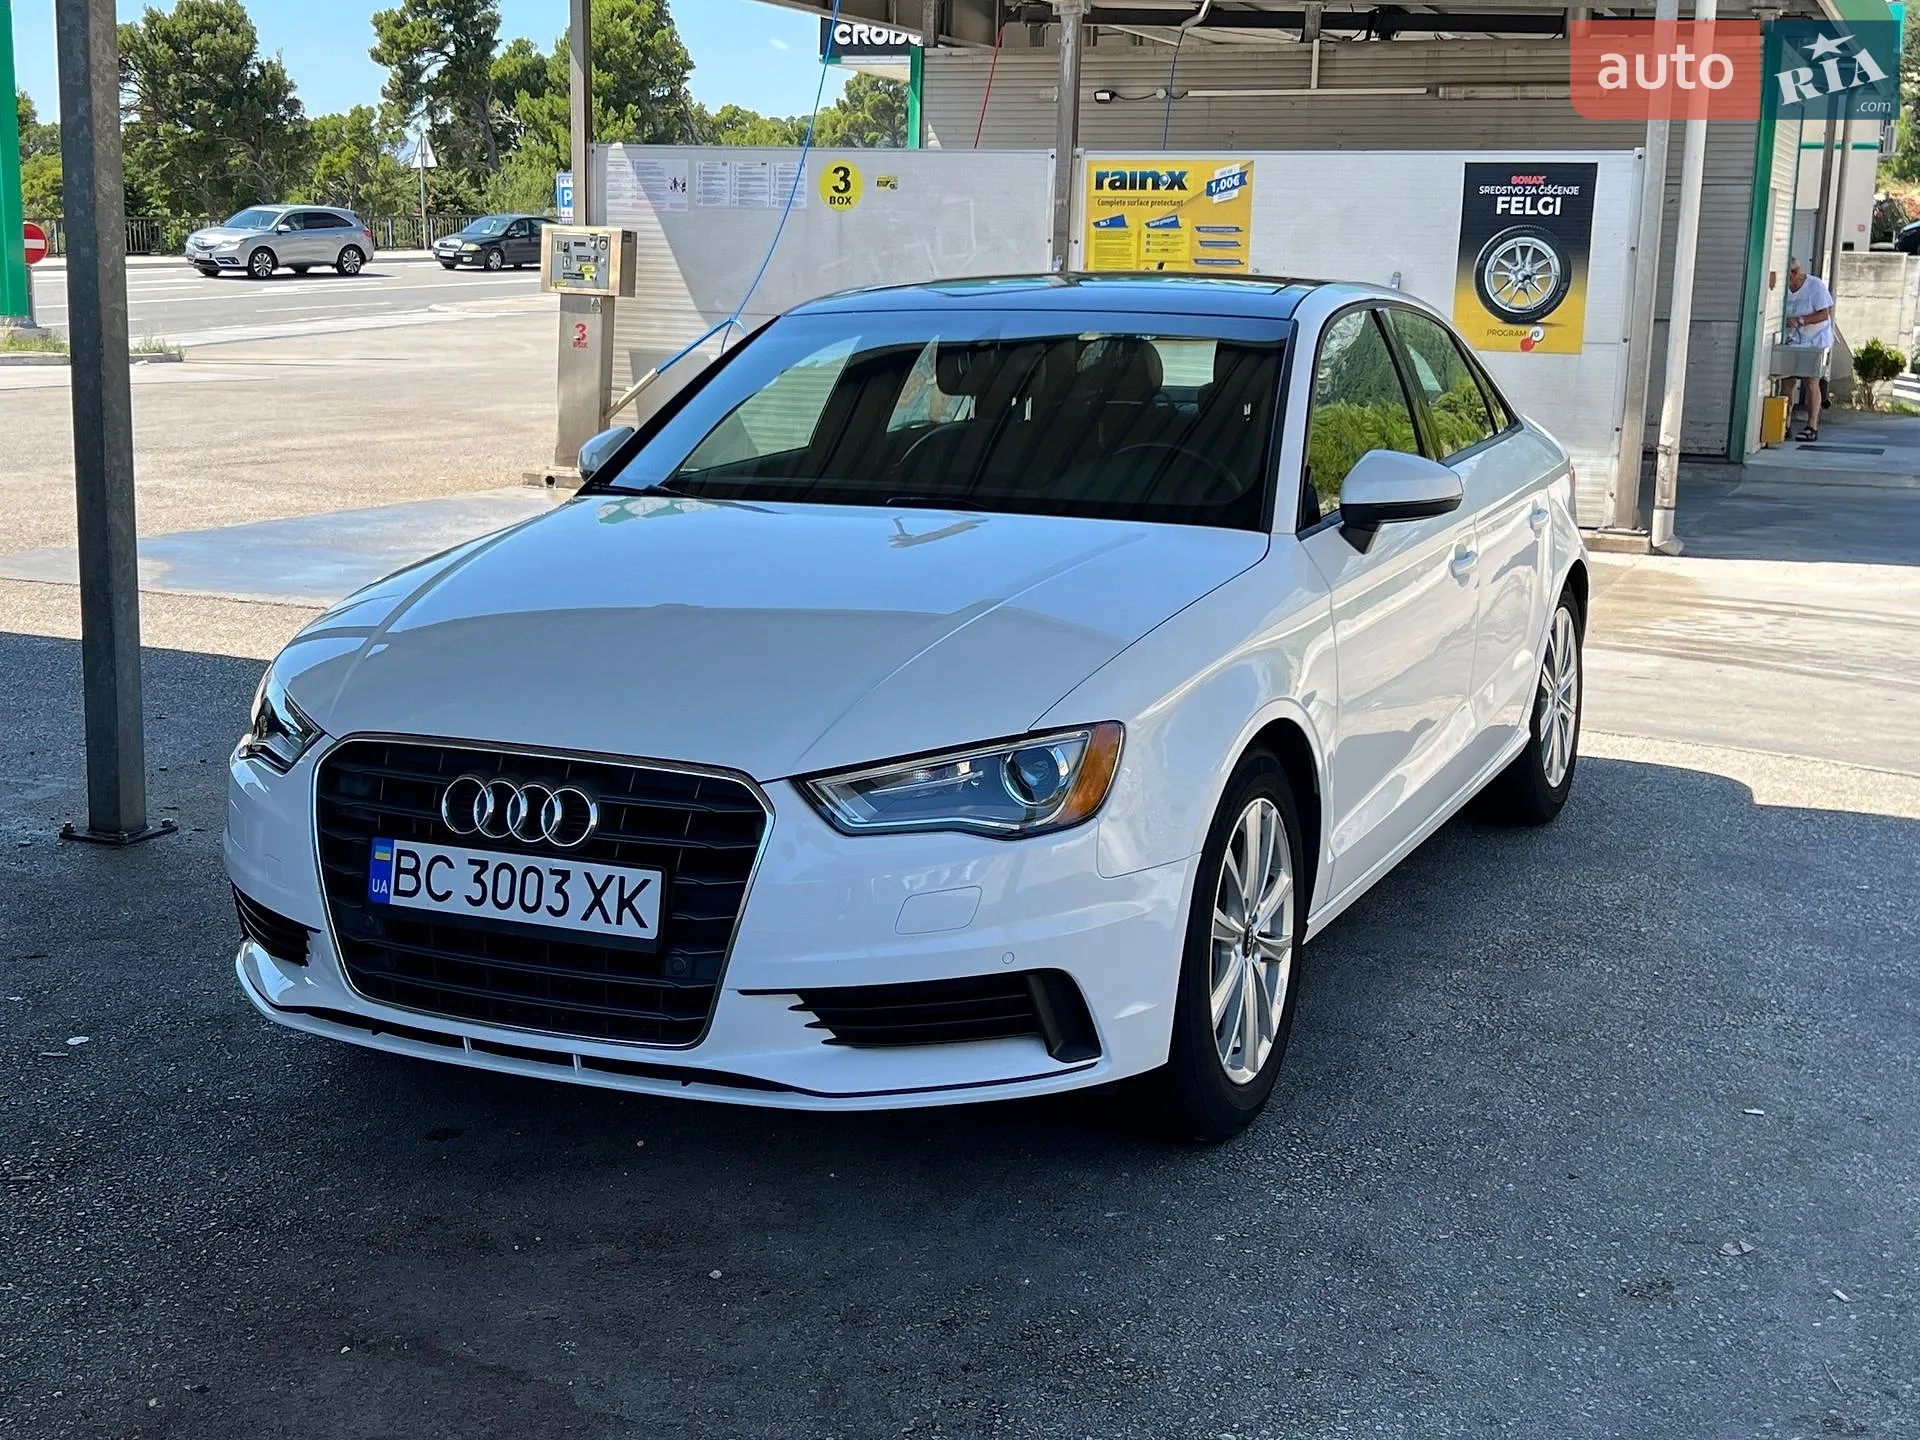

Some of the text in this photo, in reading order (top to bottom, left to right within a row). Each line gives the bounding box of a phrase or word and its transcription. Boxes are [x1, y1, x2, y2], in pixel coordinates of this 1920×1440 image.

[832, 166, 851, 194] 3
[1511, 175, 1546, 185] SONAX
[1478, 186, 1524, 195] SREDSTVO
[1525, 186, 1537, 195] ZA
[563, 189, 573, 206] P
[829, 196, 852, 205] BOX
[1097, 198, 1184, 208] Complete surface protectant
[1495, 196, 1562, 216] FELGI
[1486, 328, 1527, 337] PROGRAM
[371, 877, 389, 896] UA
[393, 848, 653, 929] BC 3003 XK
